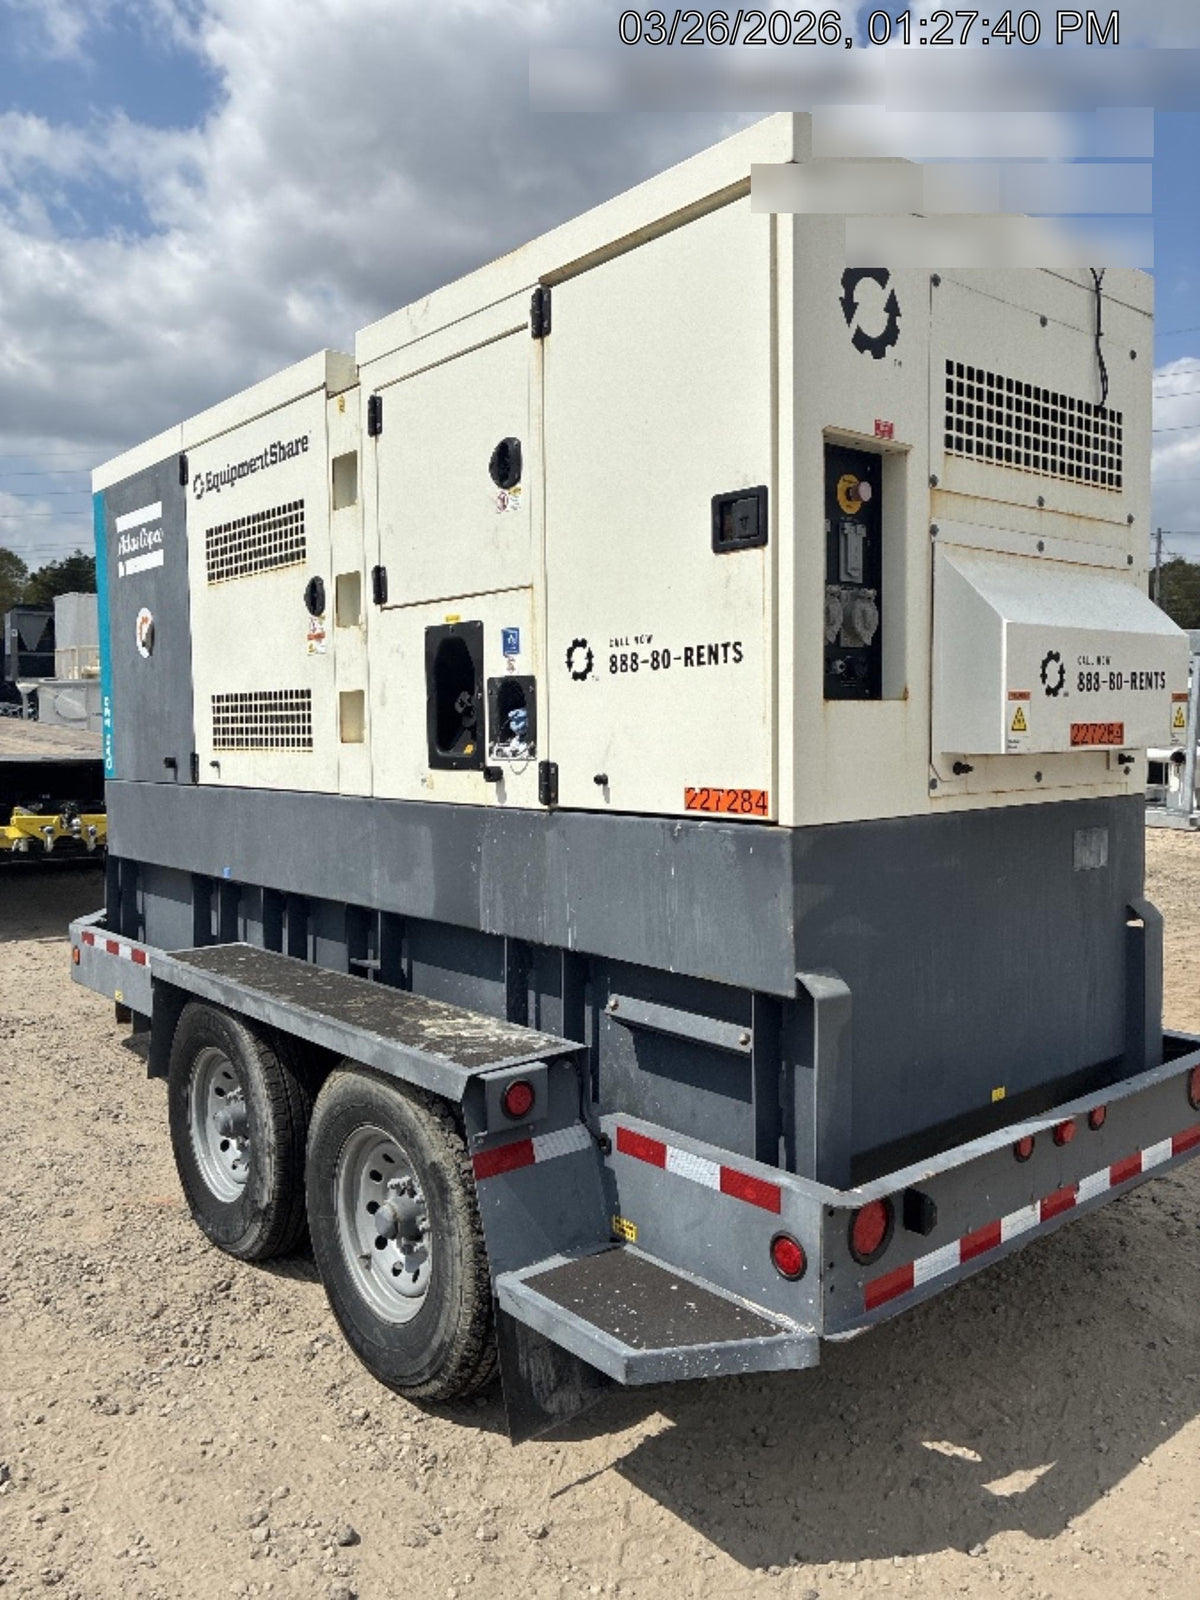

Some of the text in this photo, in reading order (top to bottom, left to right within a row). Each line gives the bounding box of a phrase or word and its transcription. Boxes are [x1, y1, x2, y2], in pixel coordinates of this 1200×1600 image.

[205, 434, 309, 493] EquipmentShare
[609, 641, 744, 674] 888-80-RENTS
[1077, 671, 1166, 692] 888-80-RENTS
[685, 787, 768, 816] 227284
